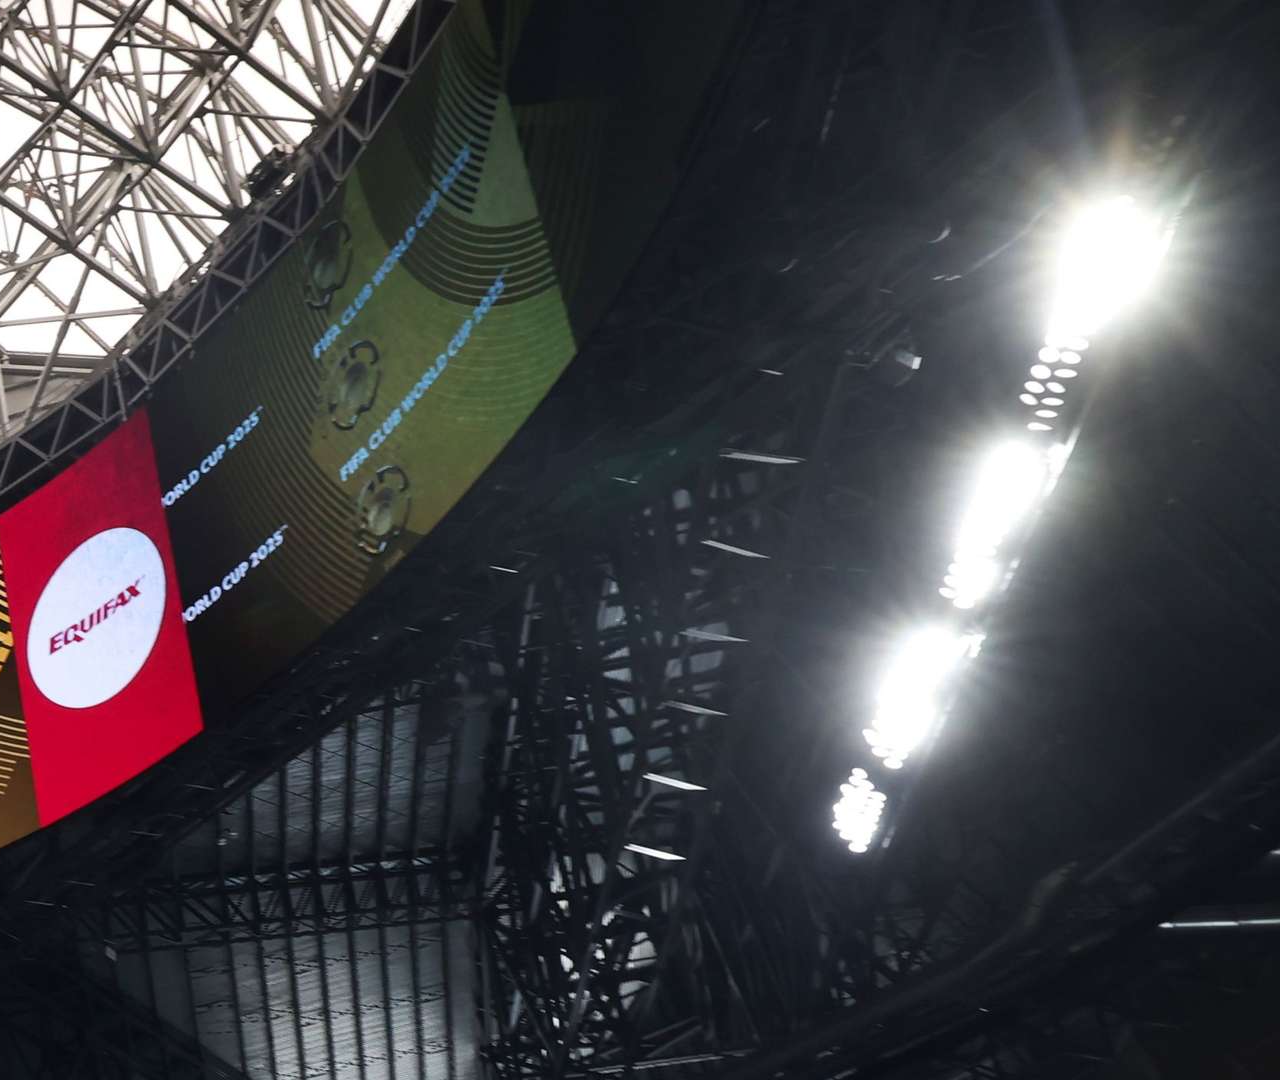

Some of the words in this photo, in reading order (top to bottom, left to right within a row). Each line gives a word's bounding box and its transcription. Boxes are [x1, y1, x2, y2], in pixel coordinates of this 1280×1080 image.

[340, 447, 369, 482] FIFA
[368, 408, 401, 450] CLUB
[401, 354, 448, 410] WORLD
[448, 319, 473, 357] CUP
[161, 469, 200, 508] ORLD
[200, 443, 226, 473] CUP
[48, 577, 142, 655] EQUIFAX
[181, 585, 222, 624] ORLD
[222, 560, 249, 590] CUP
